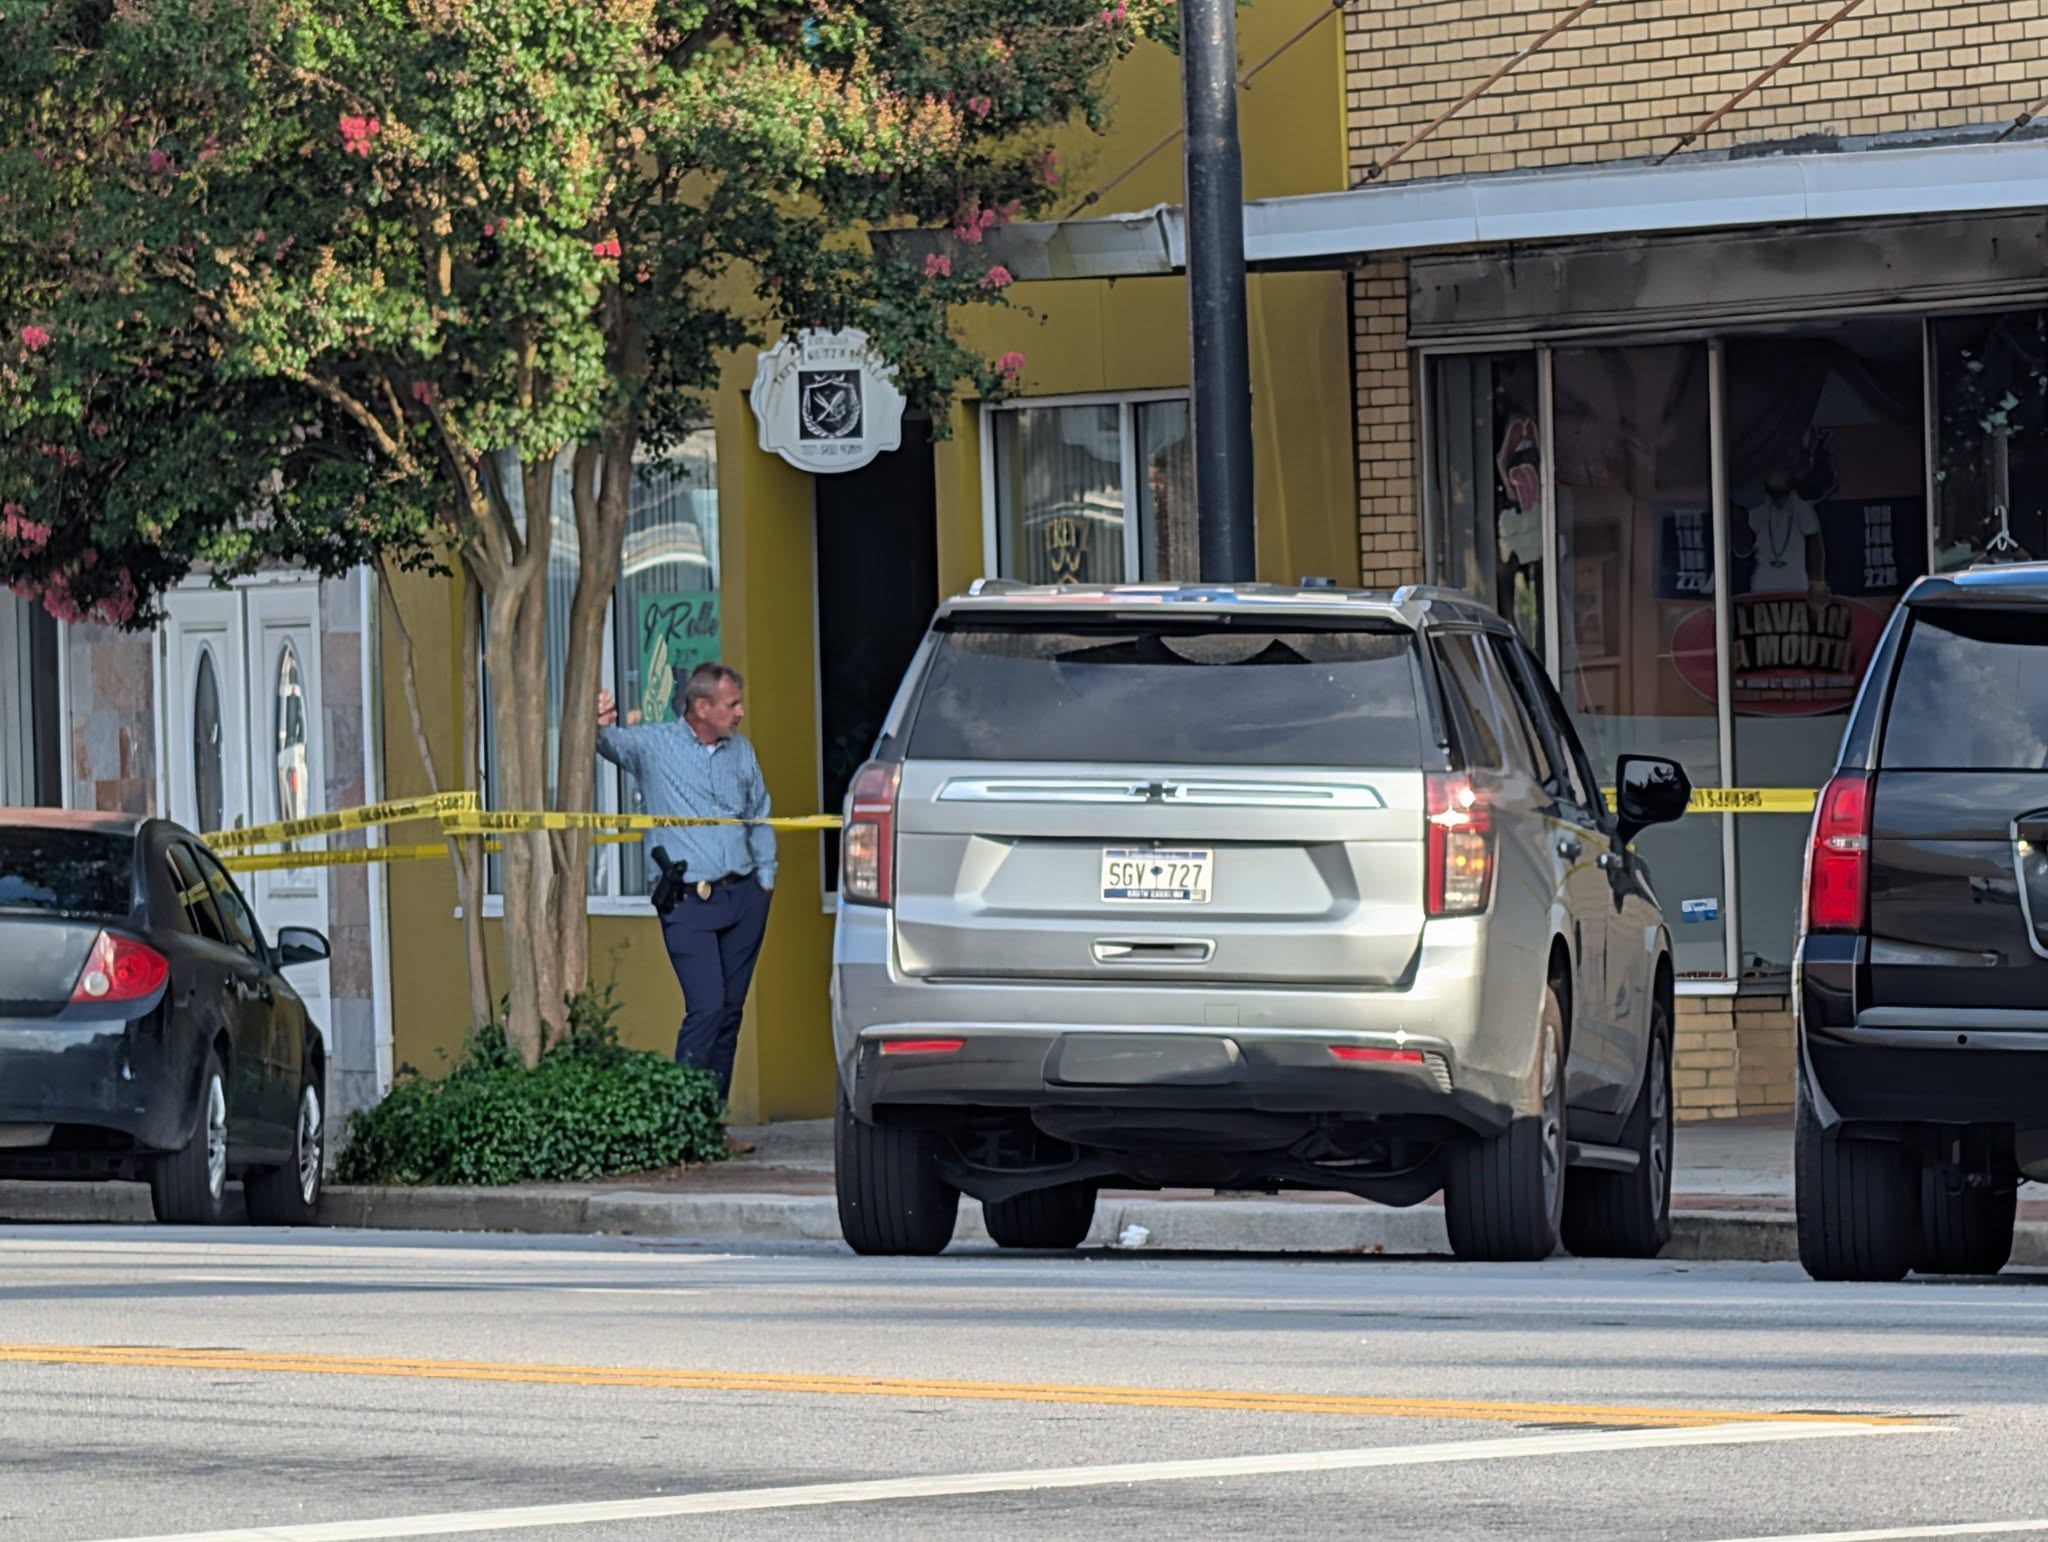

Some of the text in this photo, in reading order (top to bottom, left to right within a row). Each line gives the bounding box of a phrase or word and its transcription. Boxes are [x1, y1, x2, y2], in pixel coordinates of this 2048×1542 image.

[1736, 601, 1850, 637] LAVA IN
[1734, 634, 1852, 672] A MOUTH
[1109, 862, 1203, 889] SGV 727
